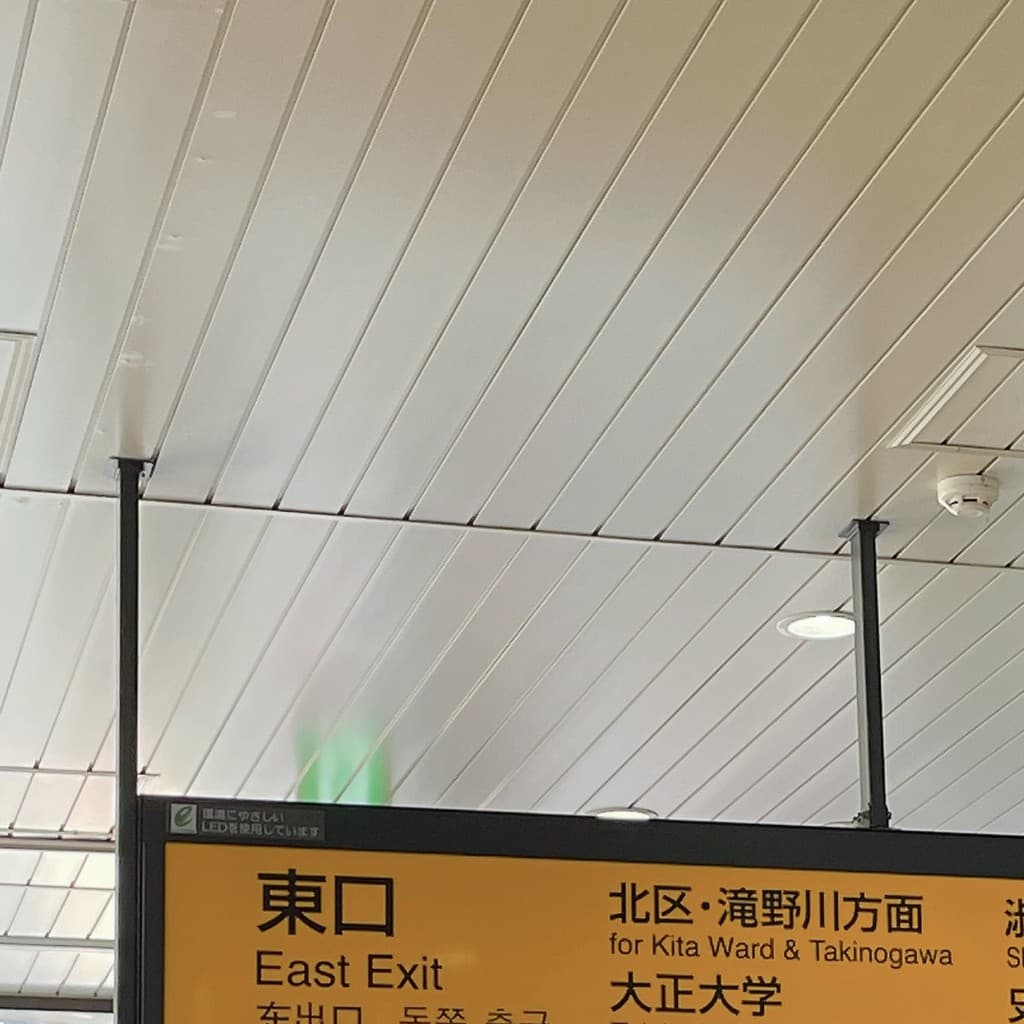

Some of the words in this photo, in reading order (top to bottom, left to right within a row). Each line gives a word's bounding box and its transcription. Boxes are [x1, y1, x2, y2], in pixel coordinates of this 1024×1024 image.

[256, 868, 394, 938] 東口
[256, 950, 350, 988] East
[367, 953, 443, 991] Exit
[609, 932, 644, 955] for
[652, 934, 701, 958] Kita
[707, 935, 775, 960] Ward
[783, 939, 801, 961] &
[809, 939, 954, 970] Takinogawa
[610, 971, 782, 1017] 大正大学
